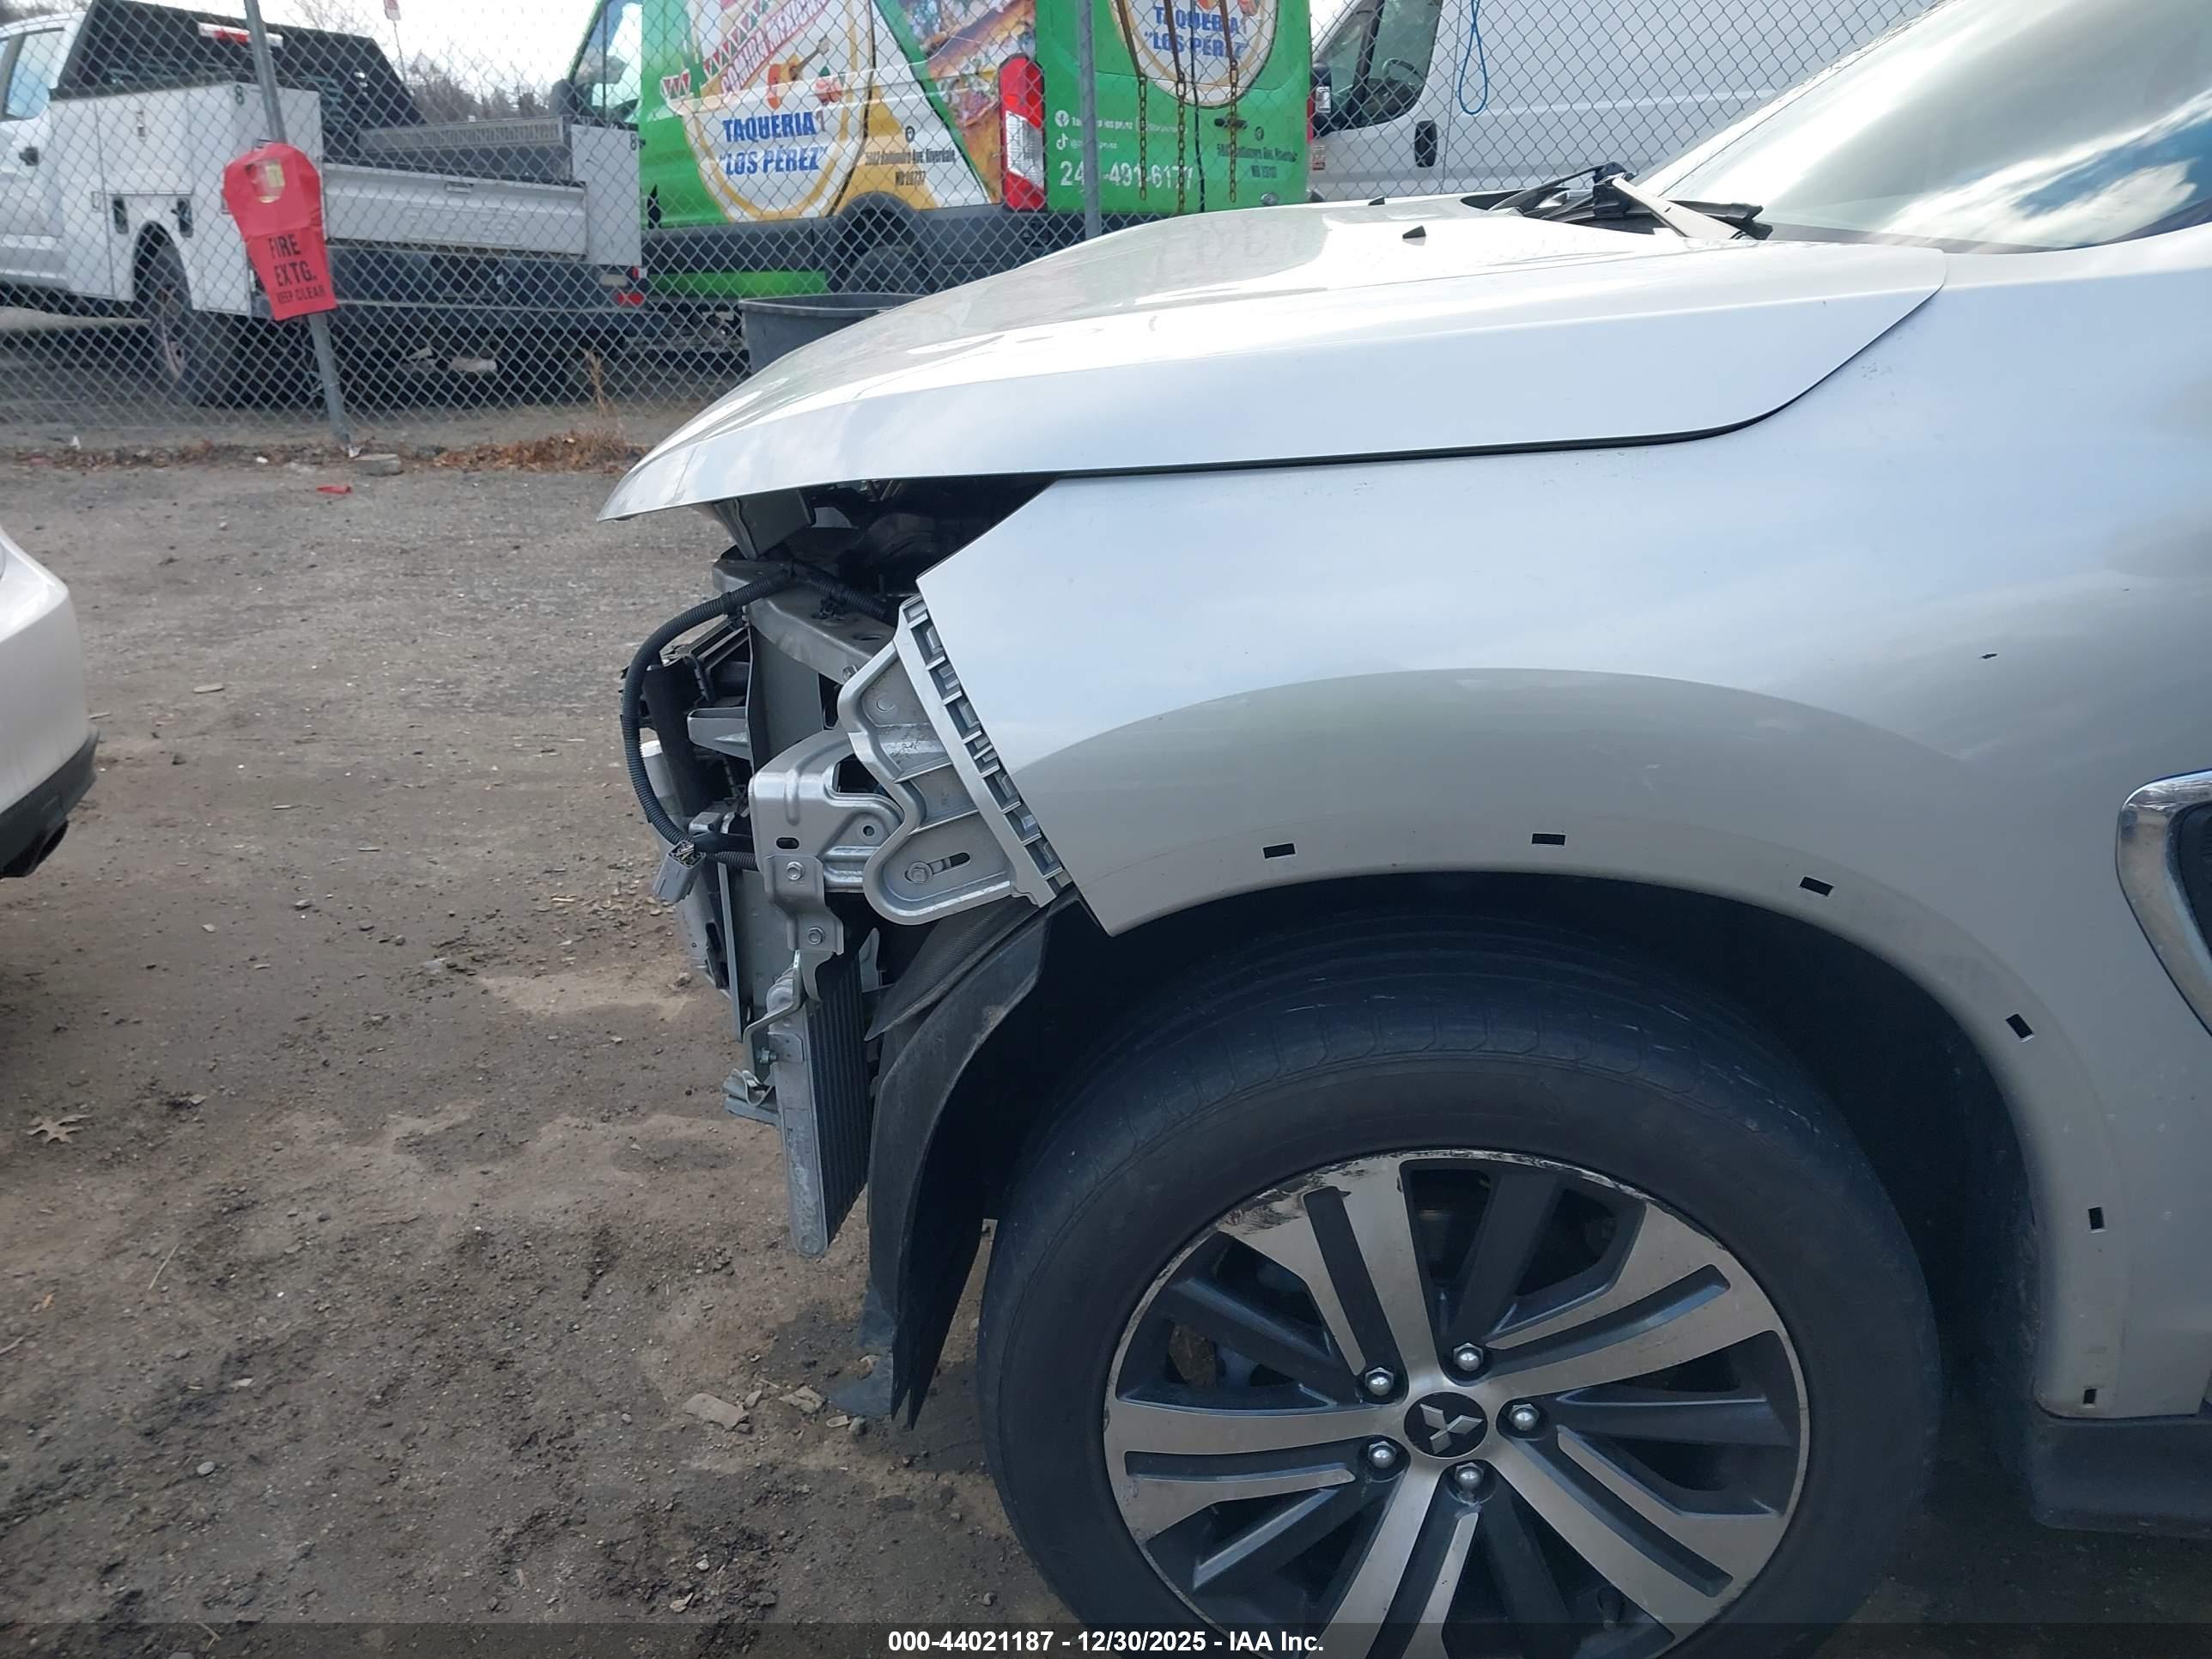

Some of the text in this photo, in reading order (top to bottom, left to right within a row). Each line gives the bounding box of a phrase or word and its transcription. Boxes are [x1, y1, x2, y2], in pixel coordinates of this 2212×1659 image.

[722, 112, 817, 143] TAQUERIA
[268, 234, 301, 259] FIRE
[274, 260, 318, 287] EXTG.
